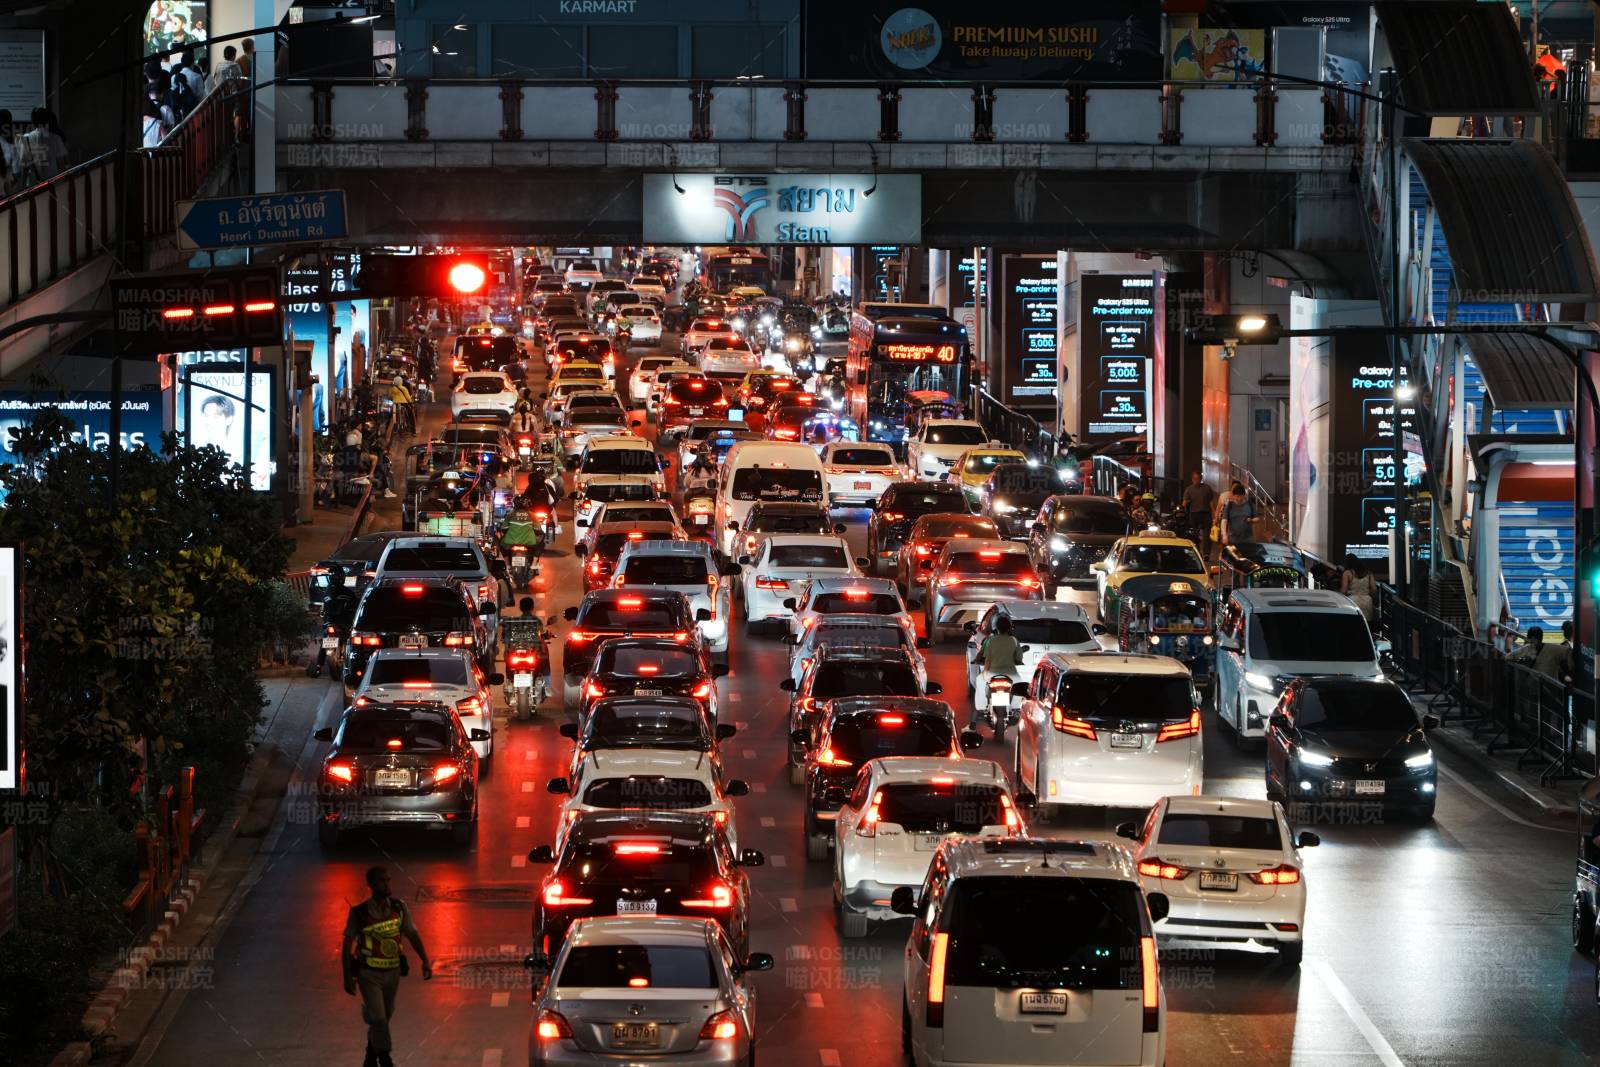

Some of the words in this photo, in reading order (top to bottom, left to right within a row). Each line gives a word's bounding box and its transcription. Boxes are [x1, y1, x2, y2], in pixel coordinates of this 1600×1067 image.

[560, 1, 636, 13] KARMART
[953, 26, 1044, 43] PREMIUM
[1047, 27, 1098, 43] SUSHI
[714, 176, 768, 186] BTS
[777, 185, 856, 212] สยาม
[220, 230, 251, 243] Henri
[257, 228, 299, 241] Dunant
[777, 222, 831, 243] Siam
[1098, 298, 1121, 307] Galaxy
[1093, 306, 1133, 315] Pre-order
[1135, 307, 1153, 315] now
[1121, 334, 1127, 343] 2
[937, 346, 954, 361] 40
[1360, 366, 1393, 377] Galaxy
[802, 492, 822, 500] Amity
[1044, 995, 1064, 1004] 5706
[632, 1026, 656, 1038] 8791
